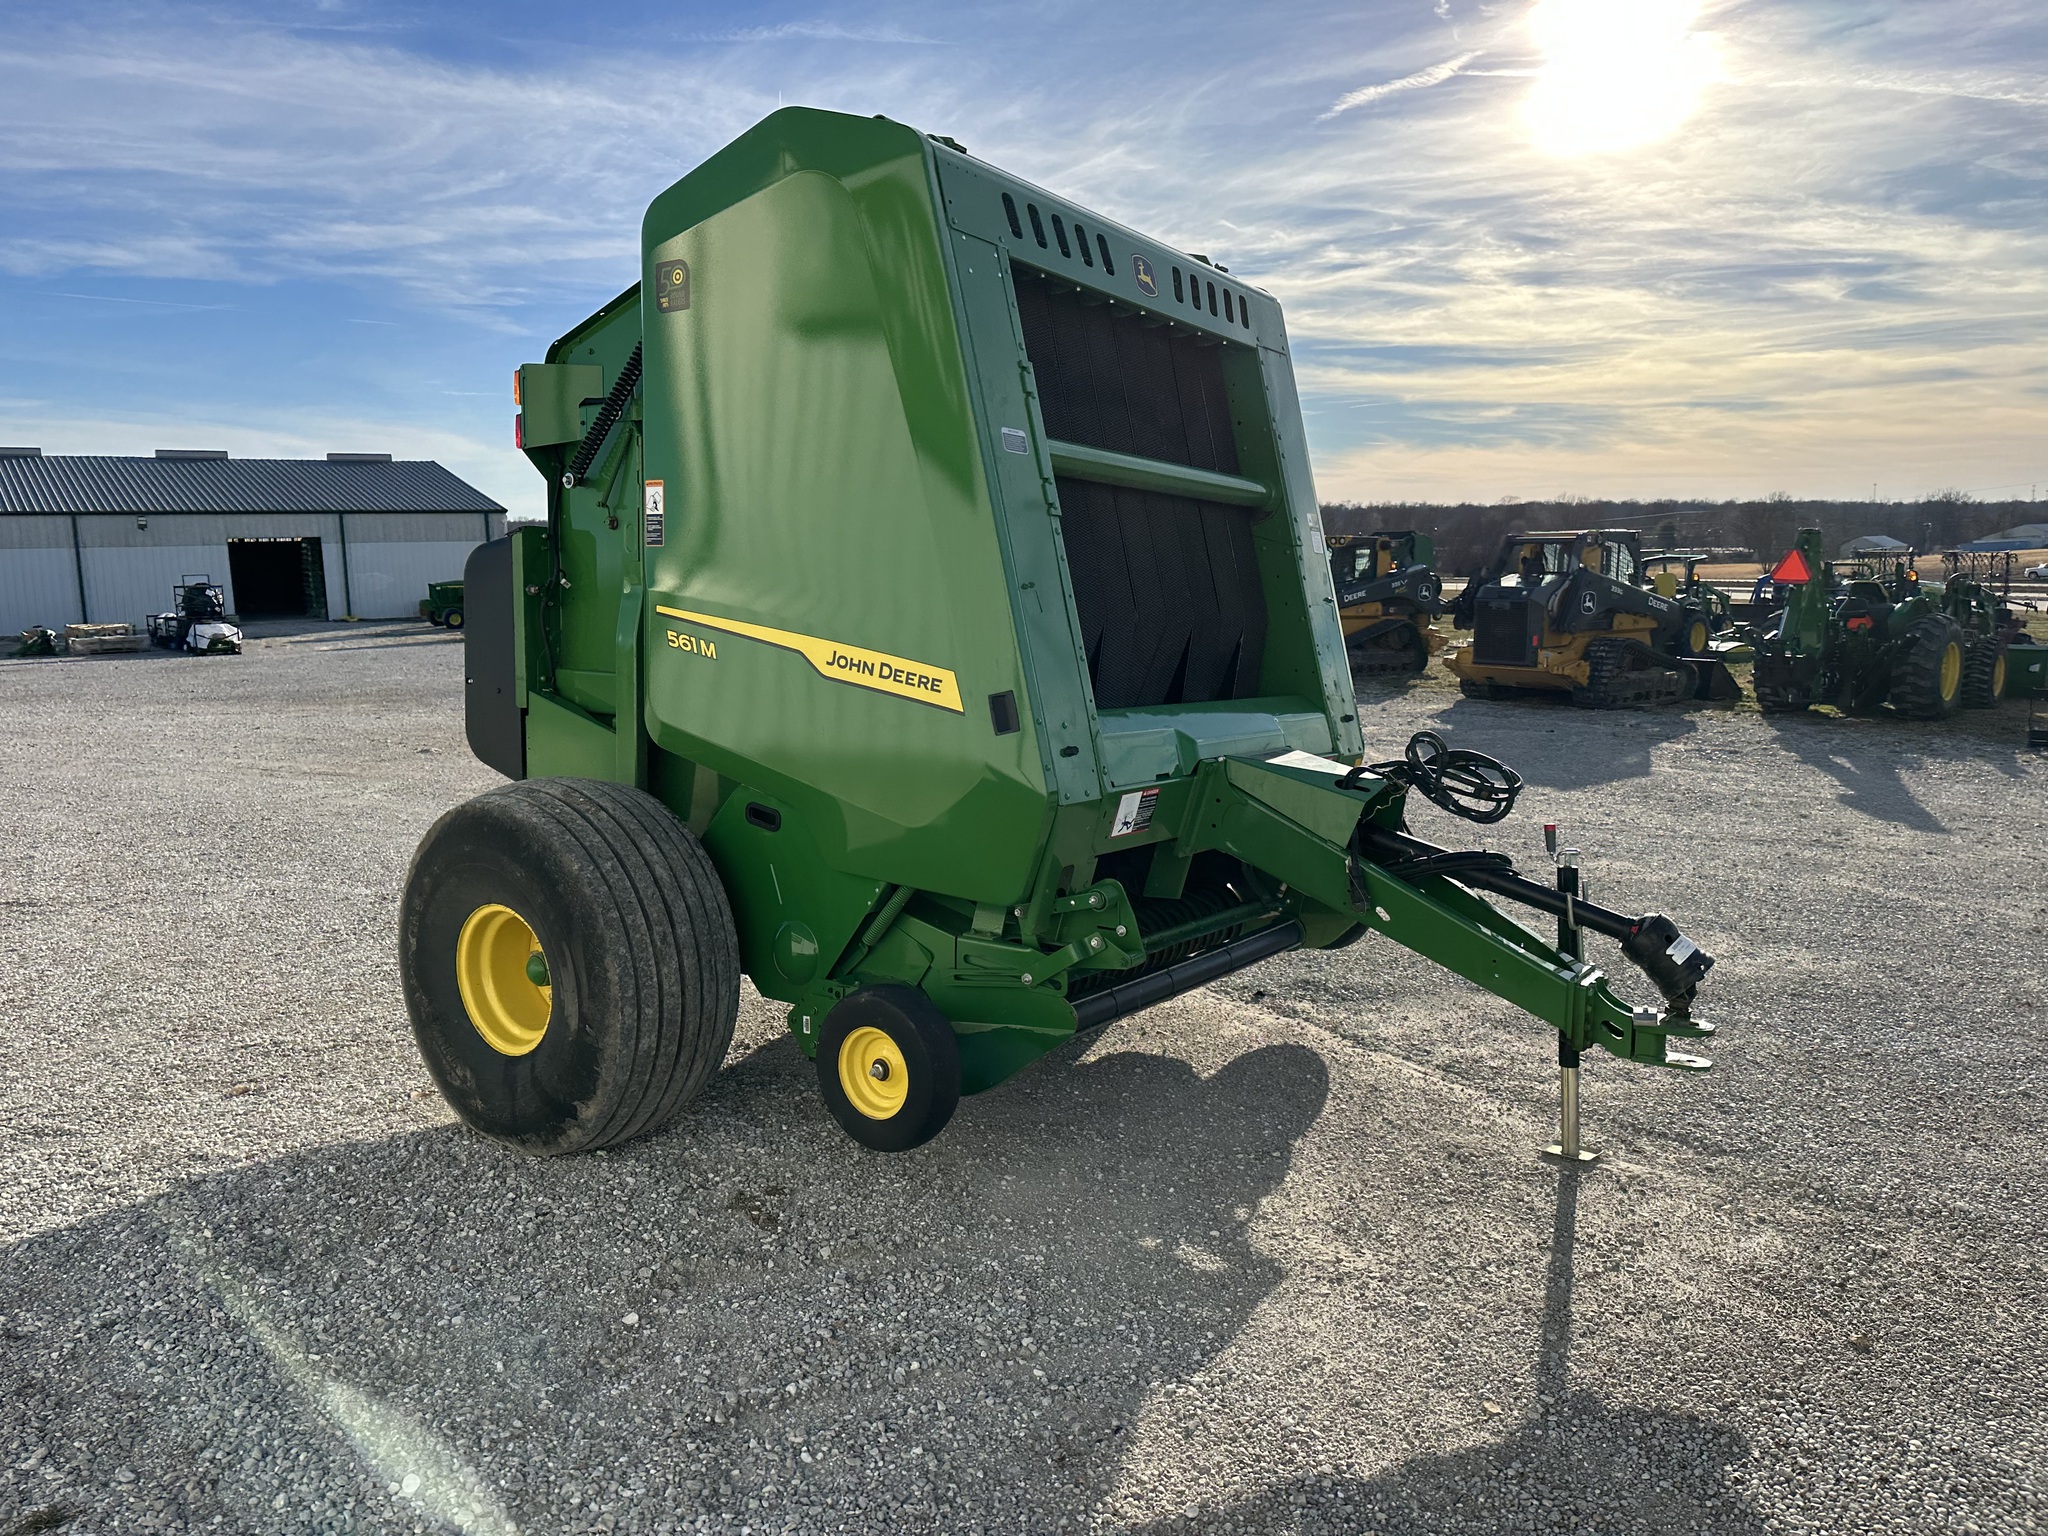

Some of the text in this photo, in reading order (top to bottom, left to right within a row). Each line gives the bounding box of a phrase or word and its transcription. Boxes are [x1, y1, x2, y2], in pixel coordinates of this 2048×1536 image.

[1343, 590, 1367, 602] DEERE
[1648, 596, 1669, 612] DEERE
[826, 650, 943, 694] JOHN DEERE
